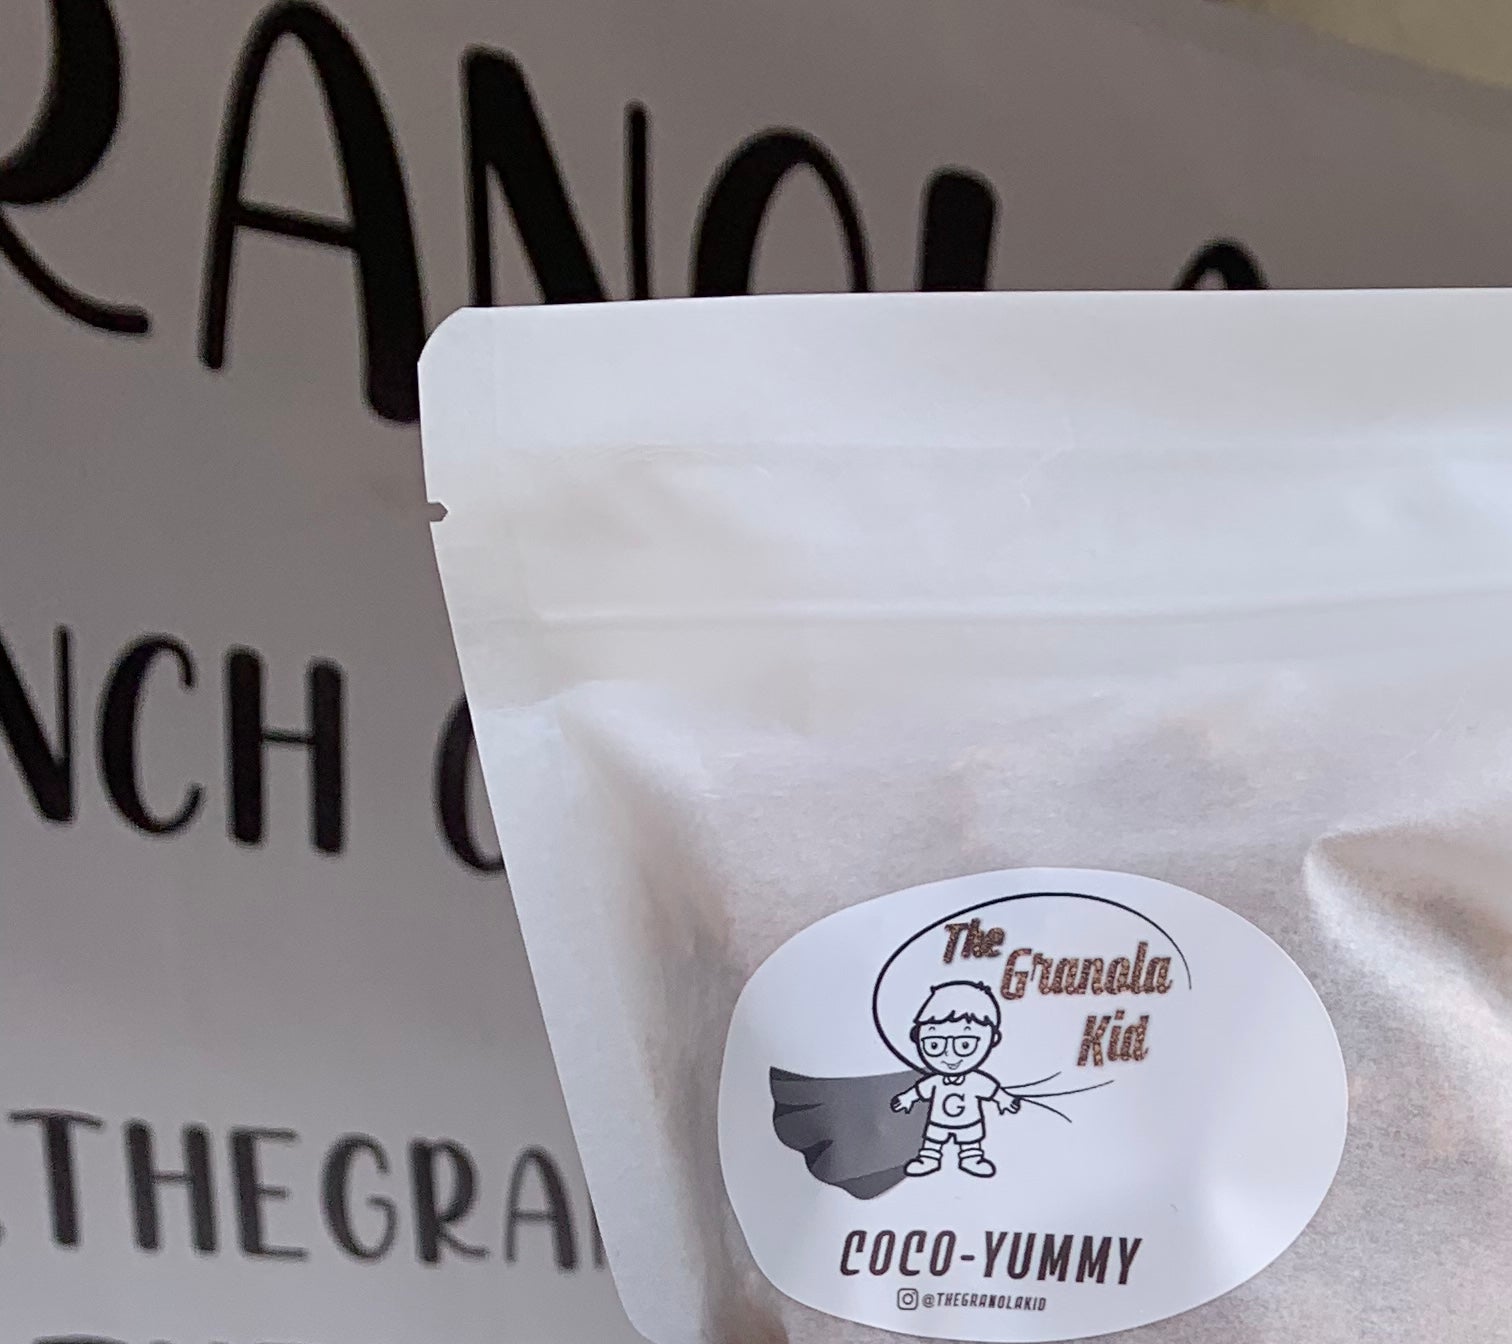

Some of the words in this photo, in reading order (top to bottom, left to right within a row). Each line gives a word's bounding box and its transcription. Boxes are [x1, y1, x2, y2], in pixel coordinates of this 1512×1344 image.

[942, 917, 1006, 965] The
[1000, 941, 1173, 1000] Granola
[1076, 1010, 1151, 1067] Kid
[942, 1092, 966, 1119] G
[8, 1108, 608, 1272] THEGRA
[840, 1229, 1142, 1286] COCO-YUMMY
[921, 1292, 1047, 1311] @THEGRANOLAKID
